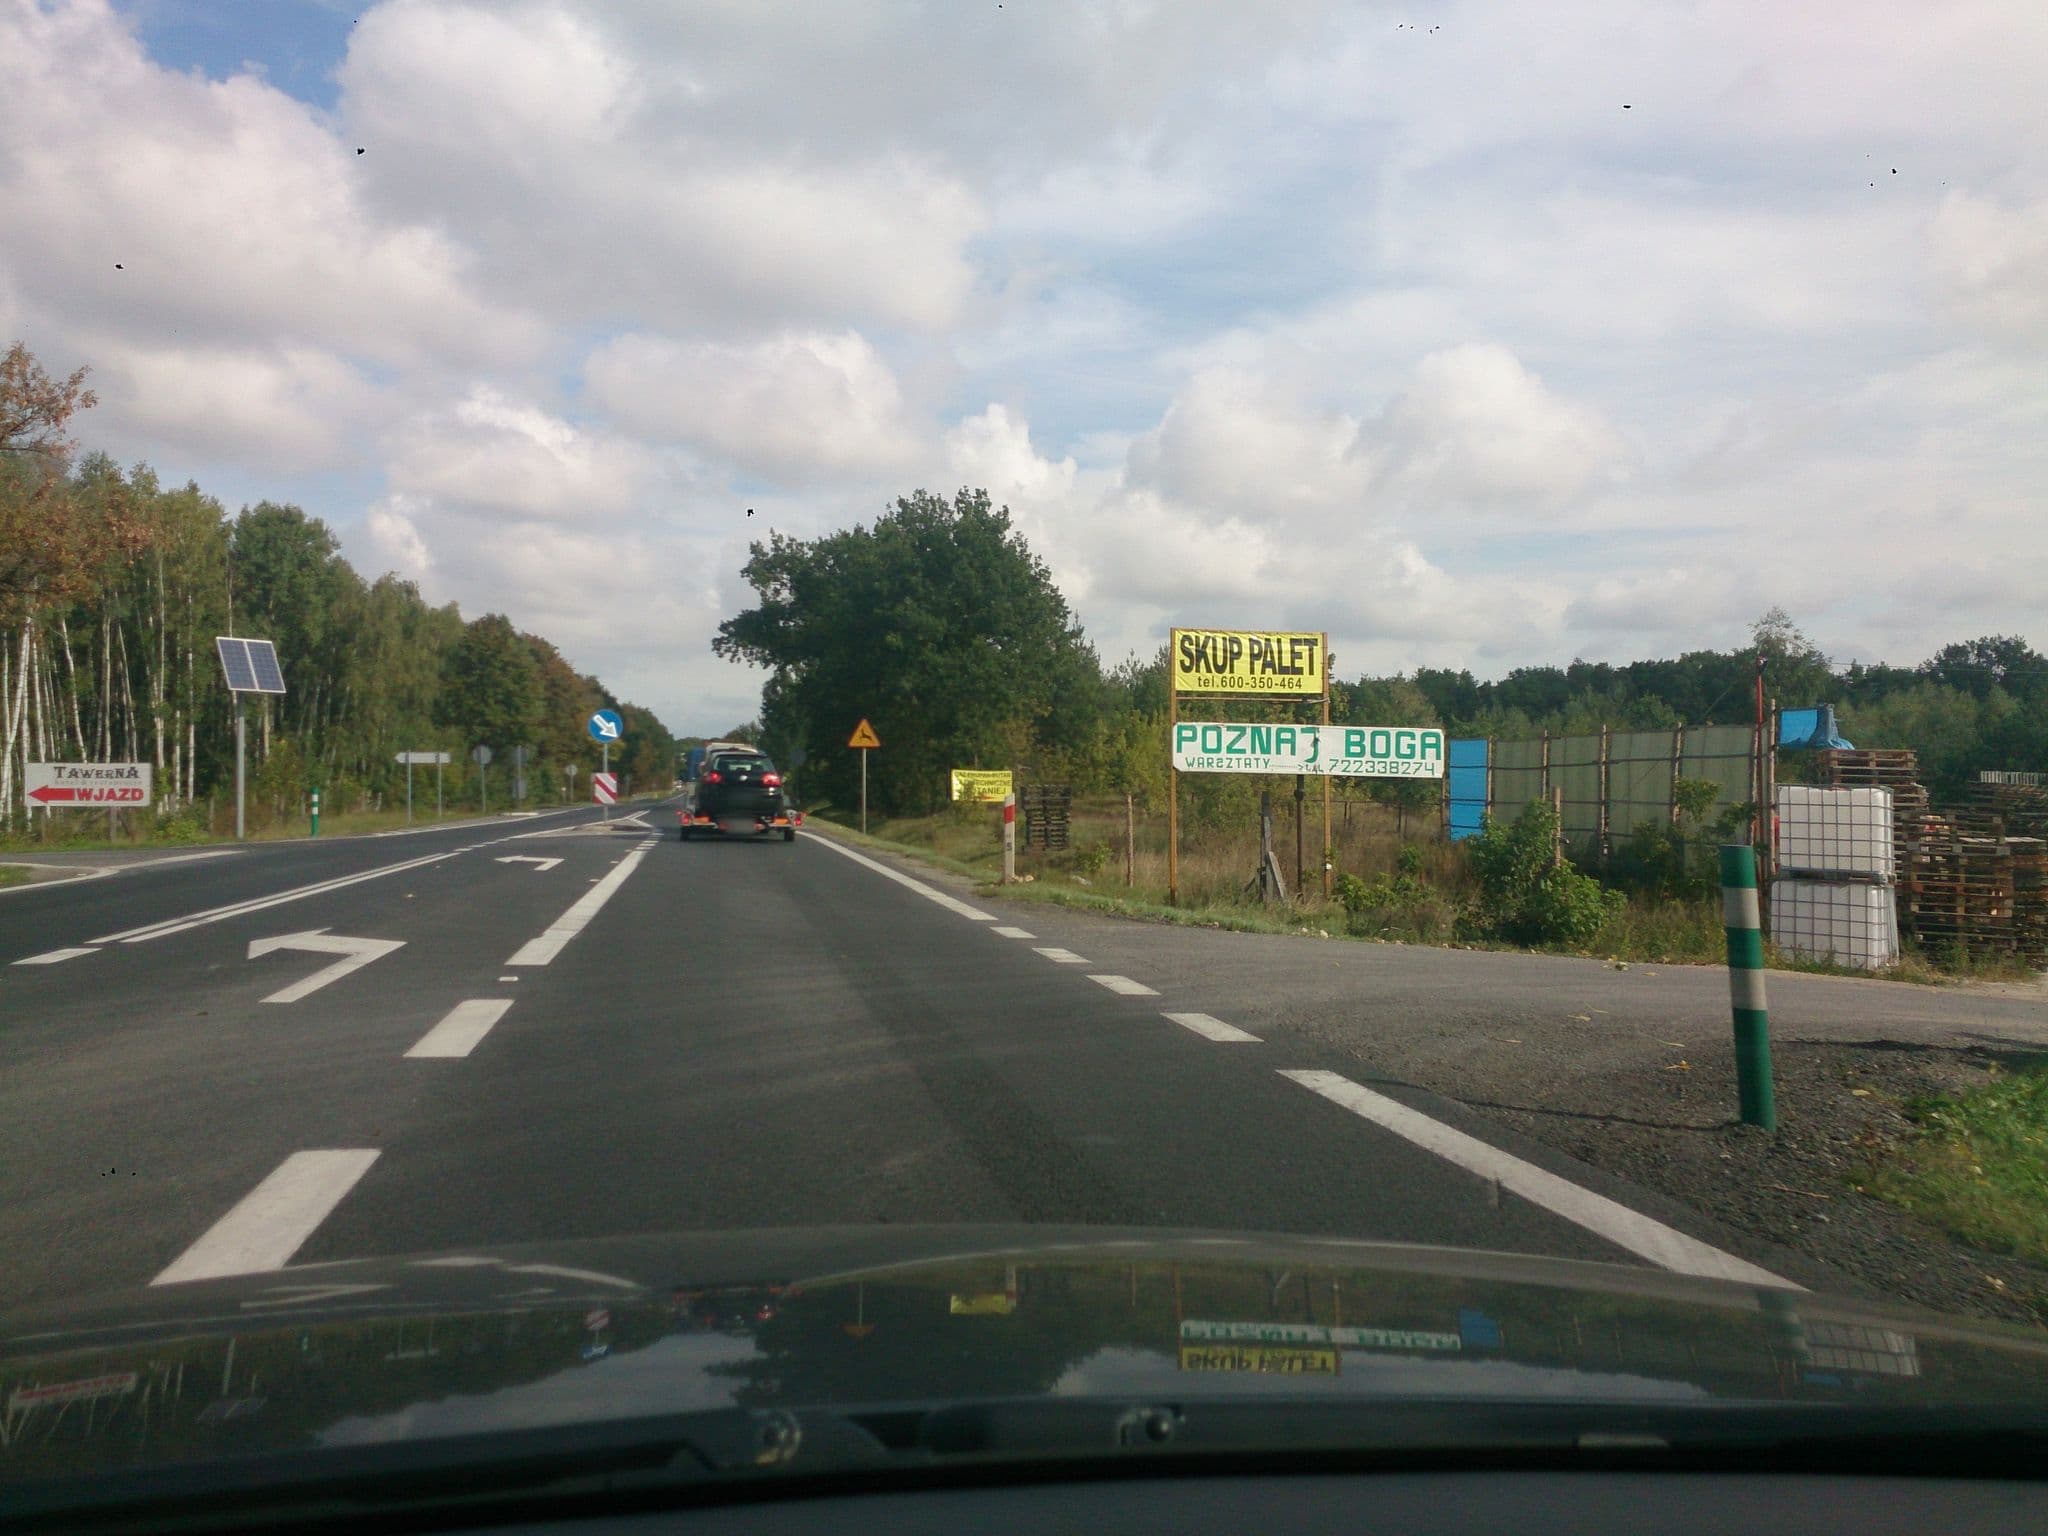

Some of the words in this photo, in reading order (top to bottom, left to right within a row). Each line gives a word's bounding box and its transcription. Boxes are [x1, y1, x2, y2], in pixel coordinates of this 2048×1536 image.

[1180, 634, 1242, 674] SKUP
[1248, 637, 1318, 675] PALET
[1197, 676, 1302, 689] tel.600-350-464
[1176, 725, 1320, 763] POZNAJ
[1345, 729, 1441, 760] BOGA
[54, 766, 140, 779] TAWERNA
[1185, 757, 1271, 769] WARSZTATY
[1328, 759, 1435, 776] 722338274
[77, 788, 144, 801] WJAZD
